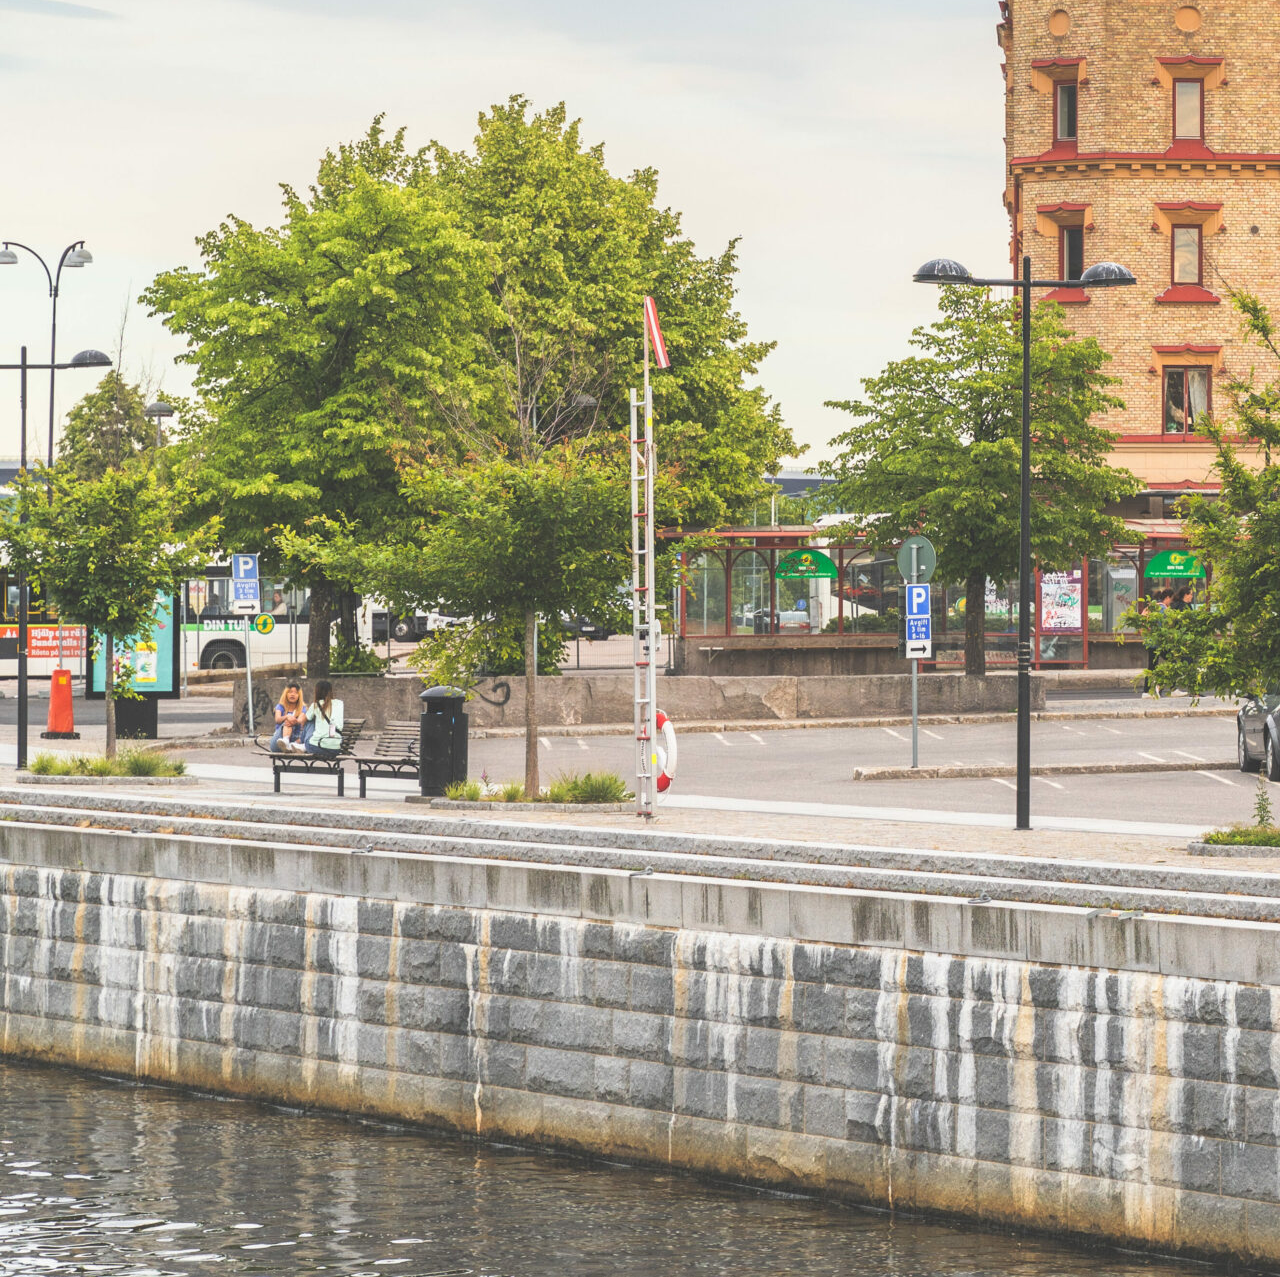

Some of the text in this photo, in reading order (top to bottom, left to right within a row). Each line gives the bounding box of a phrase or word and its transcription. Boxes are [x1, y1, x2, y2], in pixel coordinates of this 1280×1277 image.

[239, 557, 253, 577] P
[913, 587, 926, 613] P
[203, 619, 225, 631] DIN
